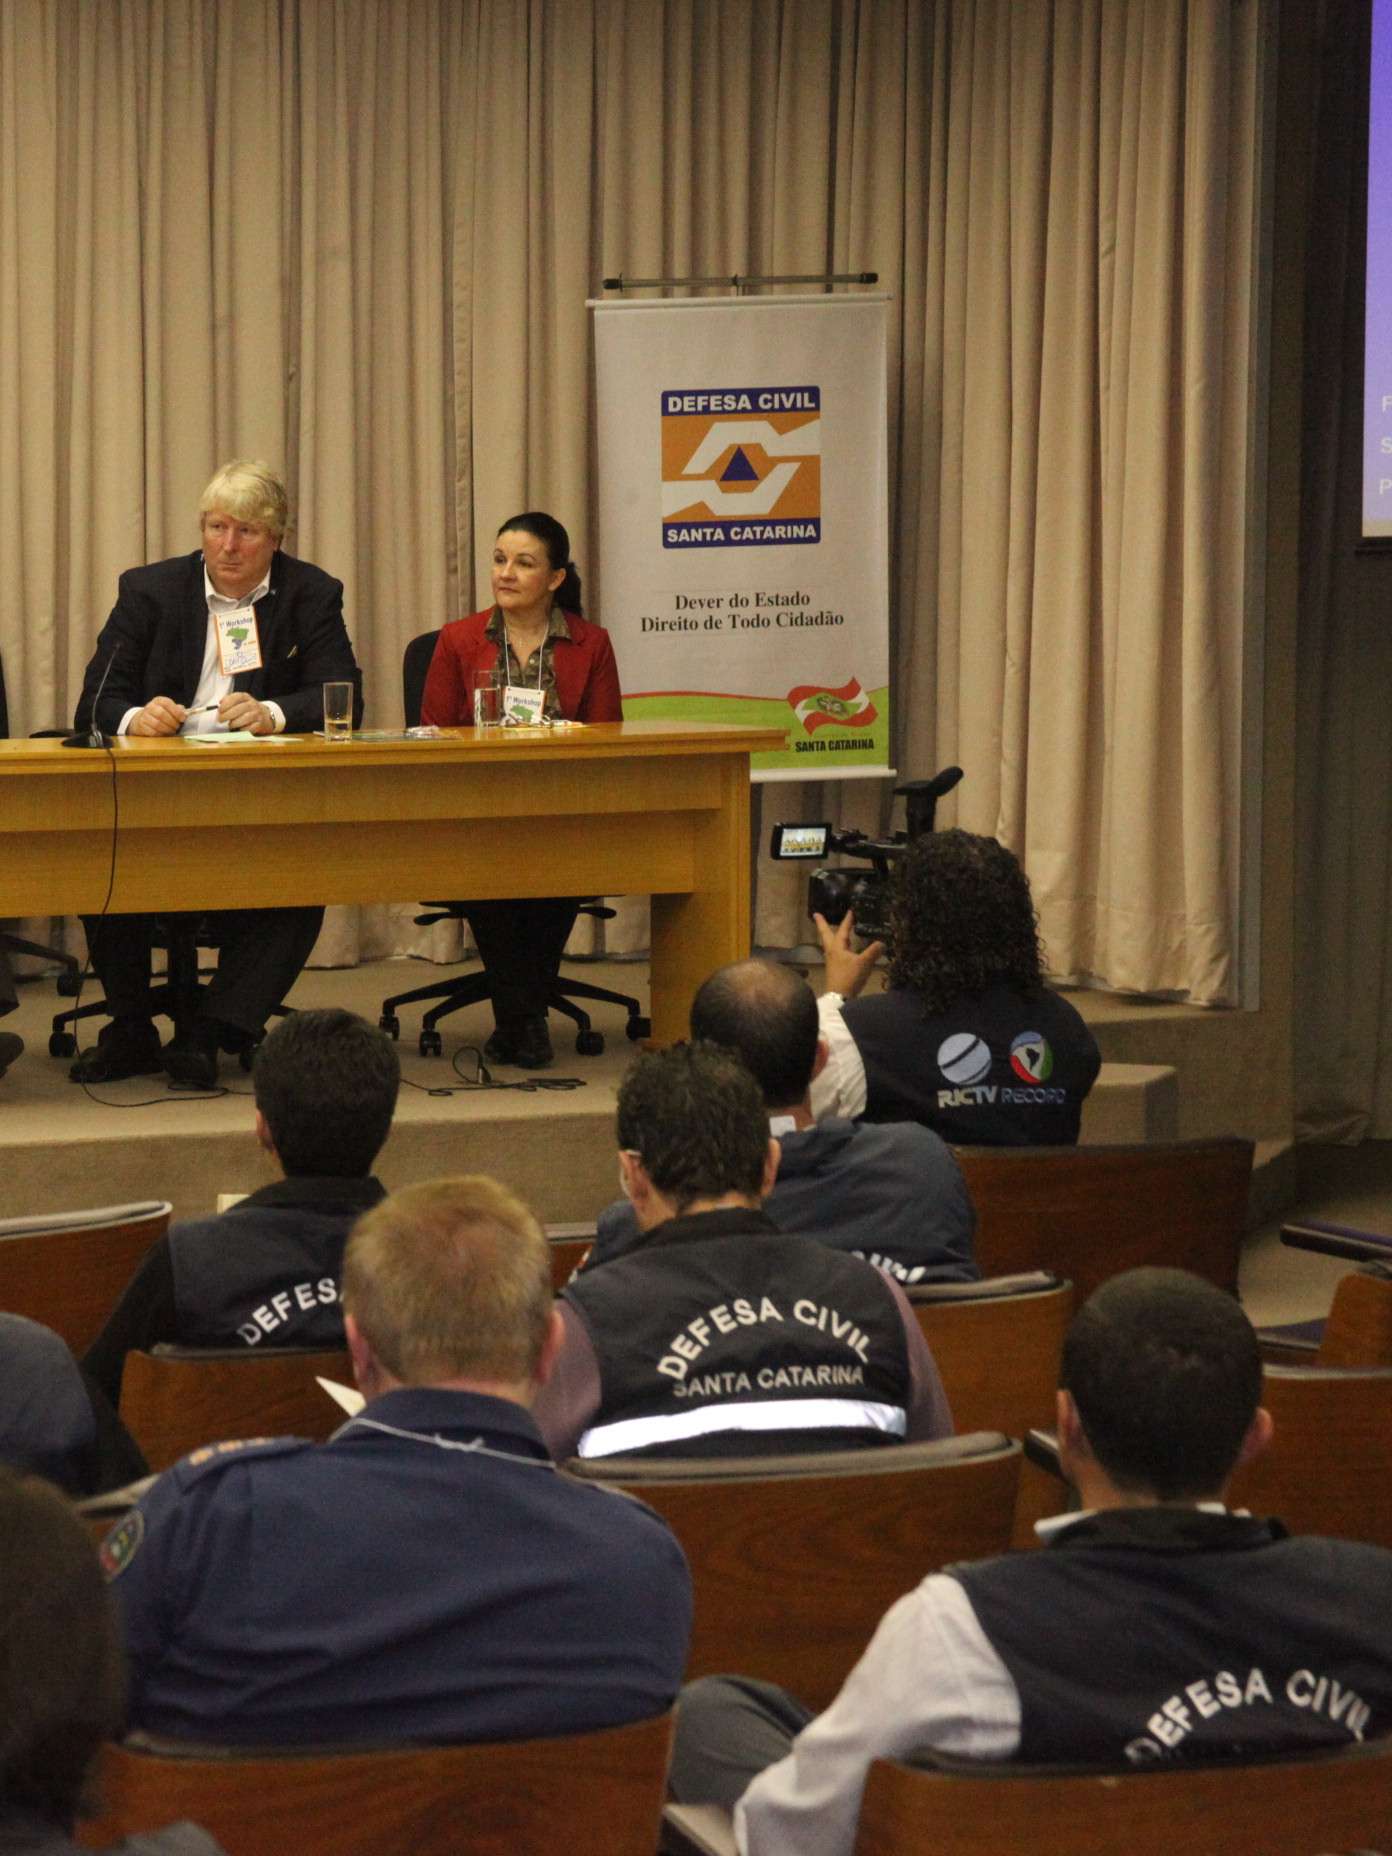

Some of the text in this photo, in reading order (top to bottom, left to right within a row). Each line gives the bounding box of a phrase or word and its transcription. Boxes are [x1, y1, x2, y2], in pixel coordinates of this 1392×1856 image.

[668, 392, 816, 413] DEFESA CIVIL
[667, 524, 817, 543] SANTA CATARINA
[675, 591, 811, 611] Dever do Estado
[226, 616, 254, 628] Workshop
[640, 610, 844, 633] Direito de Todo Cidadão
[513, 696, 542, 708] Workshop
[795, 738, 875, 753] SANTA CATARINA
[1001, 1086, 1067, 1104] RECORD
[236, 1277, 344, 1346] DEFES
[657, 1296, 869, 1381] DEFESA CIVIL
[673, 1365, 865, 1399] SANTA CATARINA
[1124, 1667, 1372, 1766] DEFESA CIVIL
